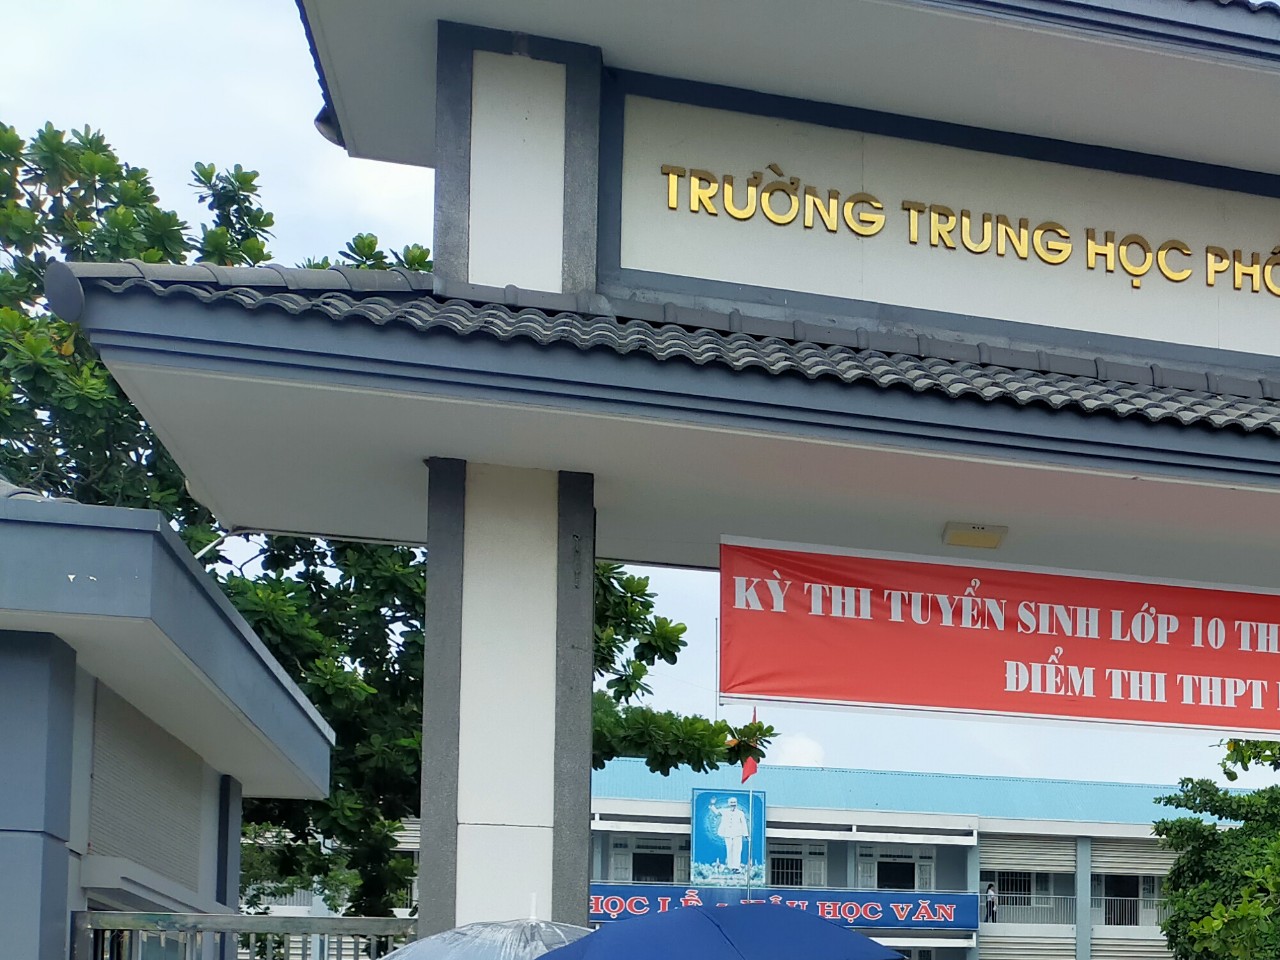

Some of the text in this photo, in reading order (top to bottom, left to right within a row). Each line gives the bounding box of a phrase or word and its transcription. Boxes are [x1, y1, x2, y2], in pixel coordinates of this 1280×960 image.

[661, 163, 886, 236] TRƯỜNG
[902, 201, 1072, 264] TRUNG
[1087, 228, 1192, 288] HỌC
[732, 569, 792, 613] KỲ
[804, 582, 874, 621] THI
[884, 578, 1008, 632] TUYỂN
[1017, 601, 1100, 639] SINH
[1109, 602, 1179, 645] LỚP
[1191, 615, 1226, 650] 10
[1004, 646, 1096, 698] ĐIỂM
[1105, 668, 1167, 703] THI
[1176, 674, 1268, 710] THPT
[817, 901, 882, 924] HỌC
[890, 900, 956, 922] VĂN
